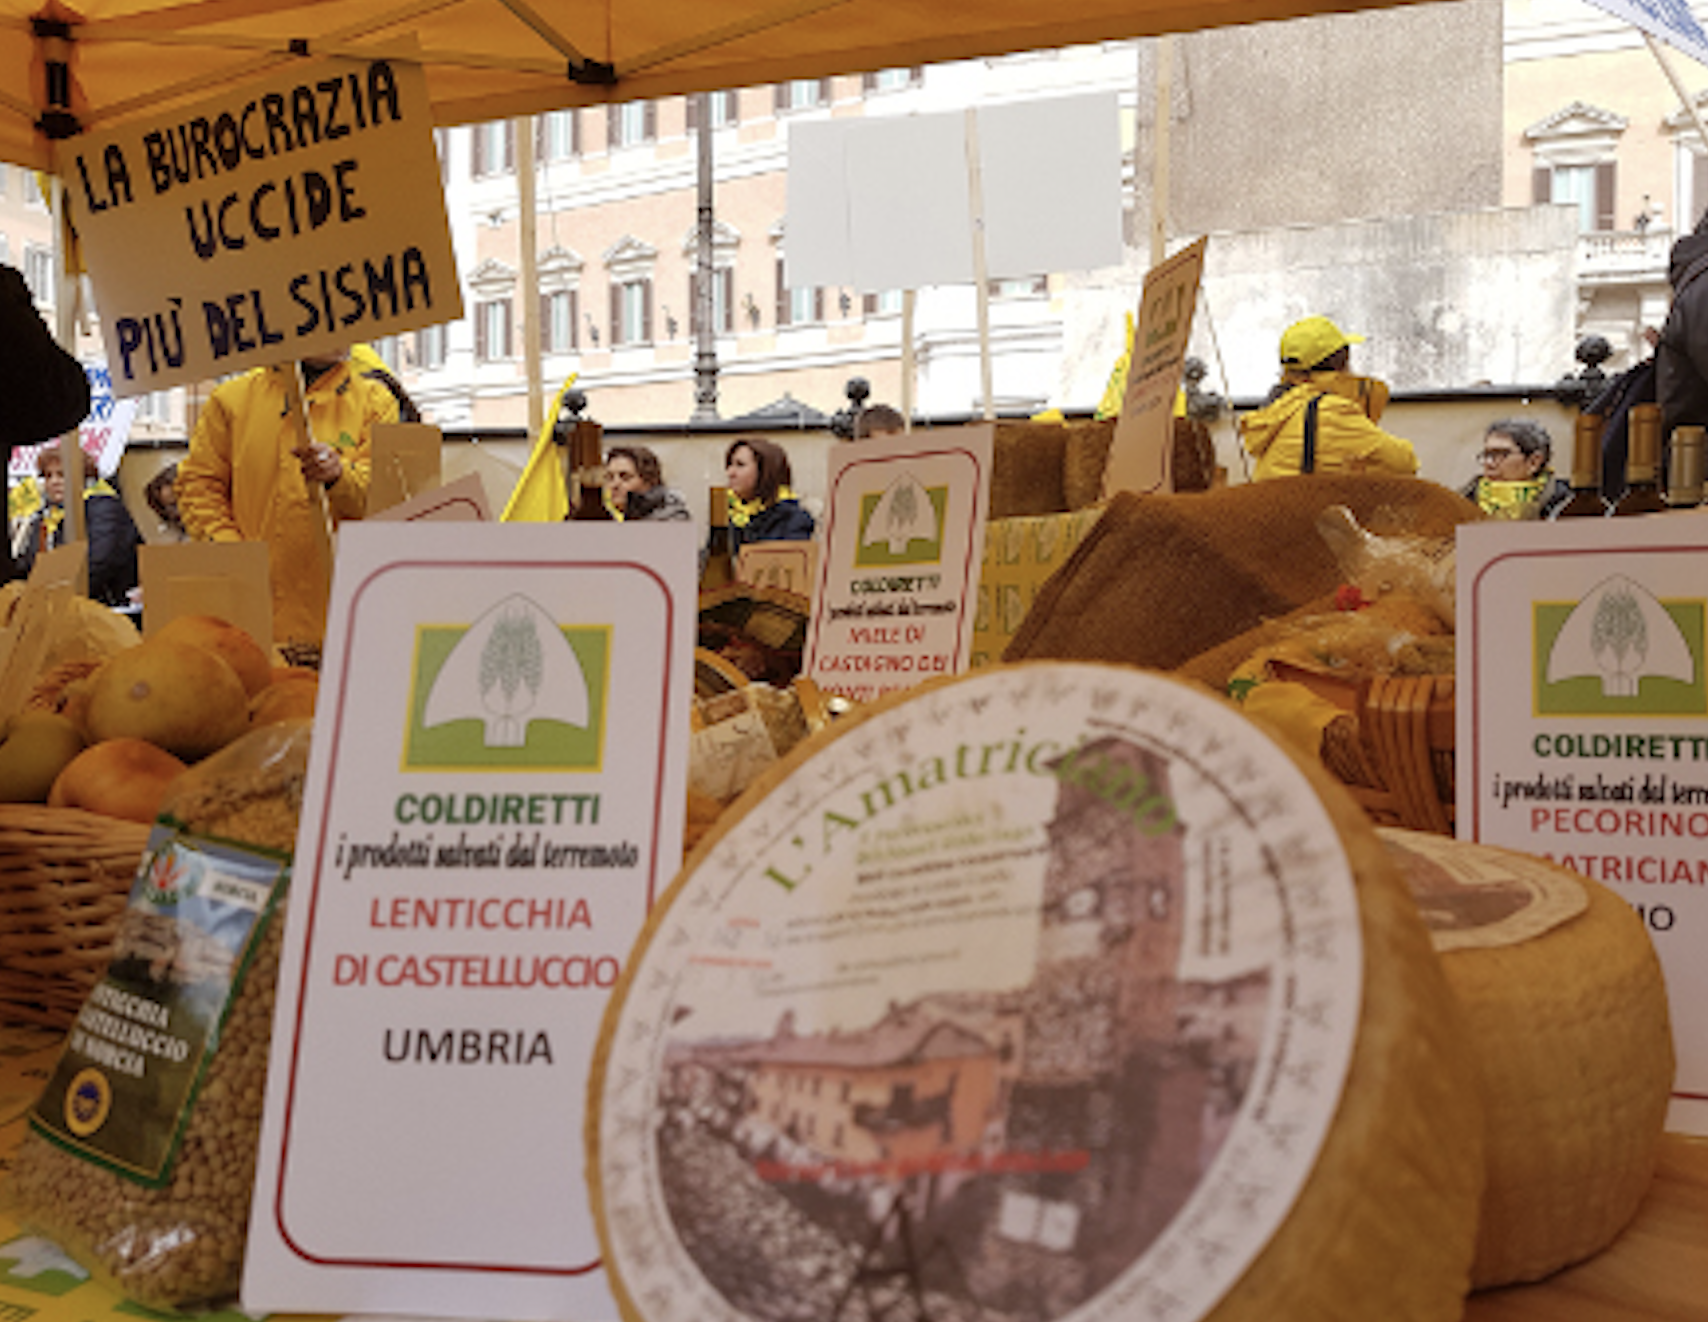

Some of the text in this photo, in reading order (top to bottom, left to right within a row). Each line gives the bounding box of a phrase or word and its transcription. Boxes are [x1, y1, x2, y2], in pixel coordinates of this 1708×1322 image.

[76, 60, 402, 213] LA BUROCRAZIA
[185, 159, 366, 259] UCCIDE
[116, 246, 432, 380] PIÙ DEL SISMA
[394, 793, 600, 825] COLDIRETTI
[1501, 772, 1574, 810] prodotti
[1579, 773, 1634, 803] salvati
[1531, 808, 1708, 839] PECORINO
[340, 832, 433, 881] prodotti
[434, 832, 503, 869] salvati
[505, 832, 541, 869] dal
[542, 840, 639, 869] terremoto
[369, 897, 592, 930] LENTICCHIA
[332, 954, 621, 989] DI CASTELLUCCIO
[383, 1029, 554, 1065] UMBRIA
